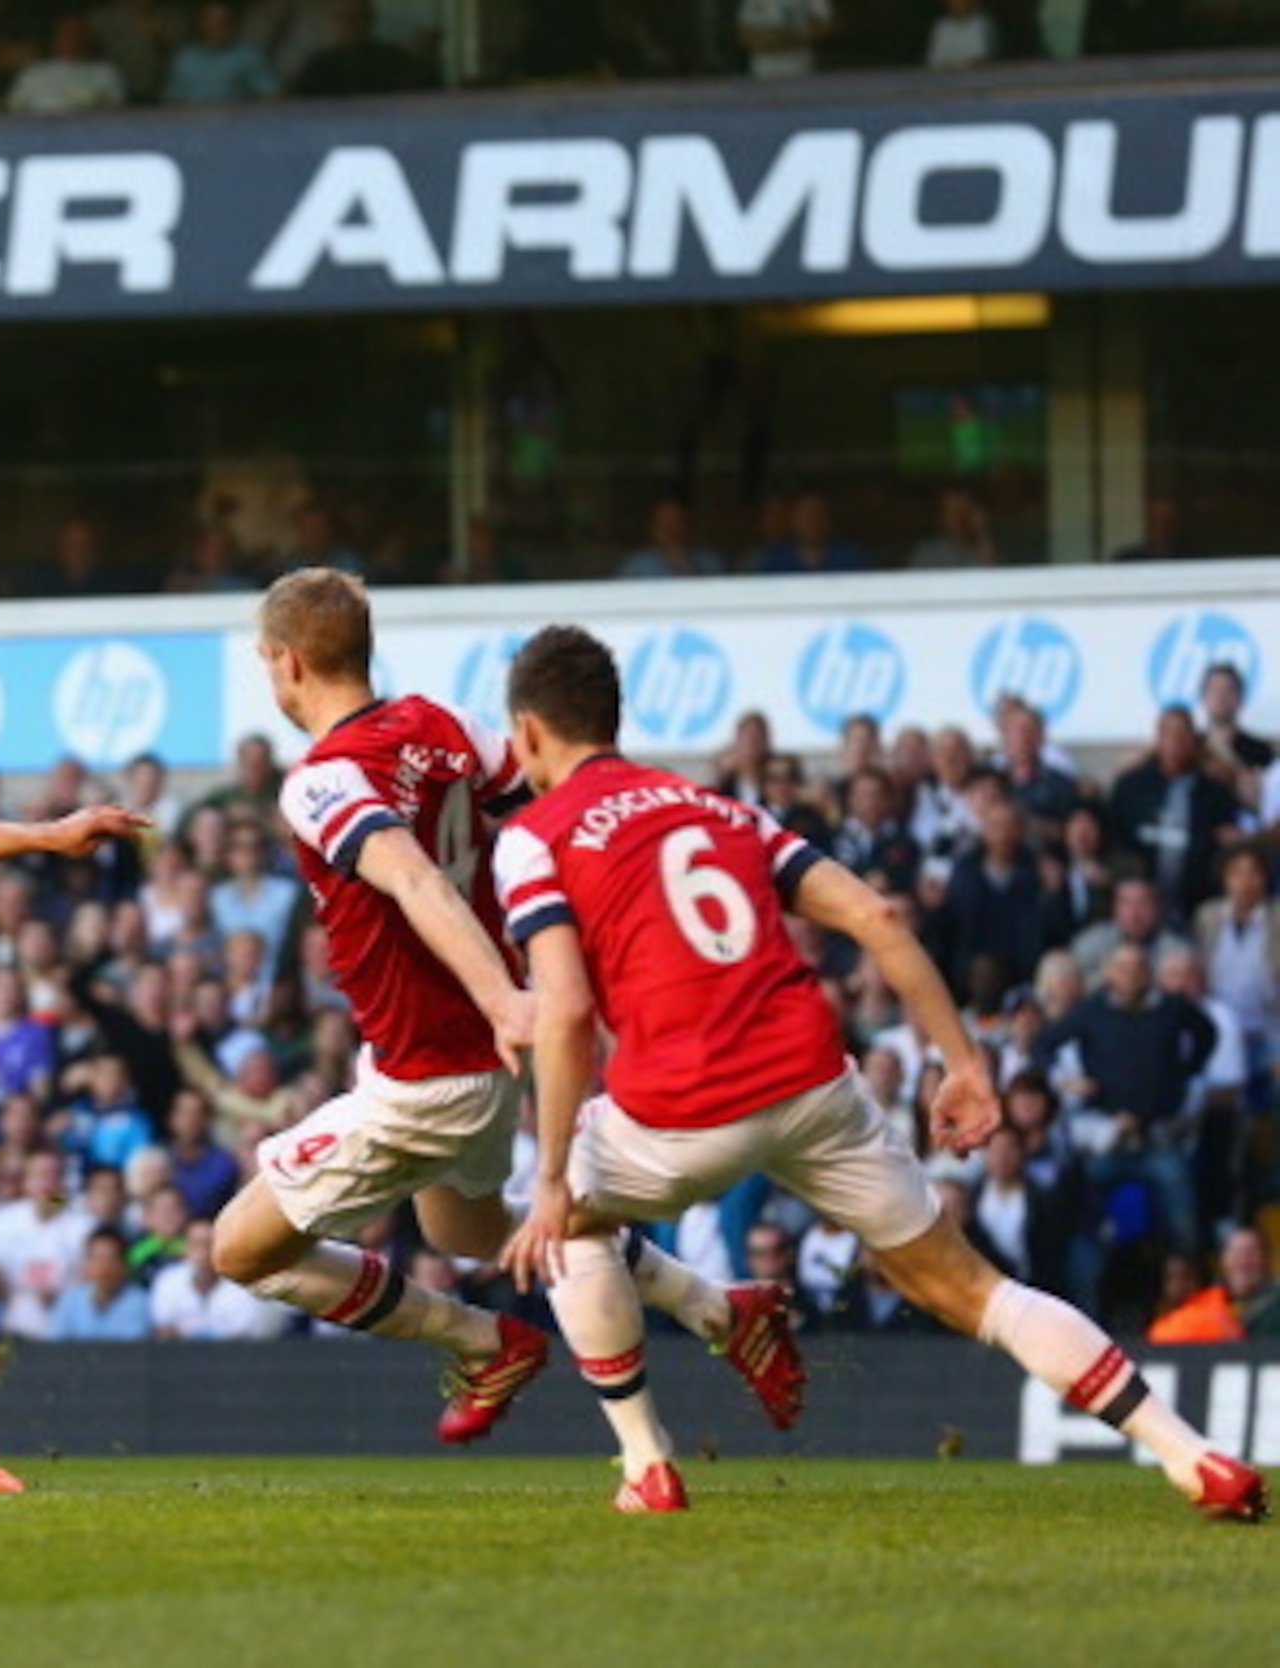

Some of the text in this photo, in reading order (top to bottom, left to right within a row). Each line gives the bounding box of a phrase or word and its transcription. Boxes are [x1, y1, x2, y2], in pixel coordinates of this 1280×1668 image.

[247, 112, 1280, 290] ARMOU
[58, 641, 164, 762] hp
[630, 627, 729, 739] hp
[800, 620, 903, 734] hp
[660, 825, 757, 965] 6
